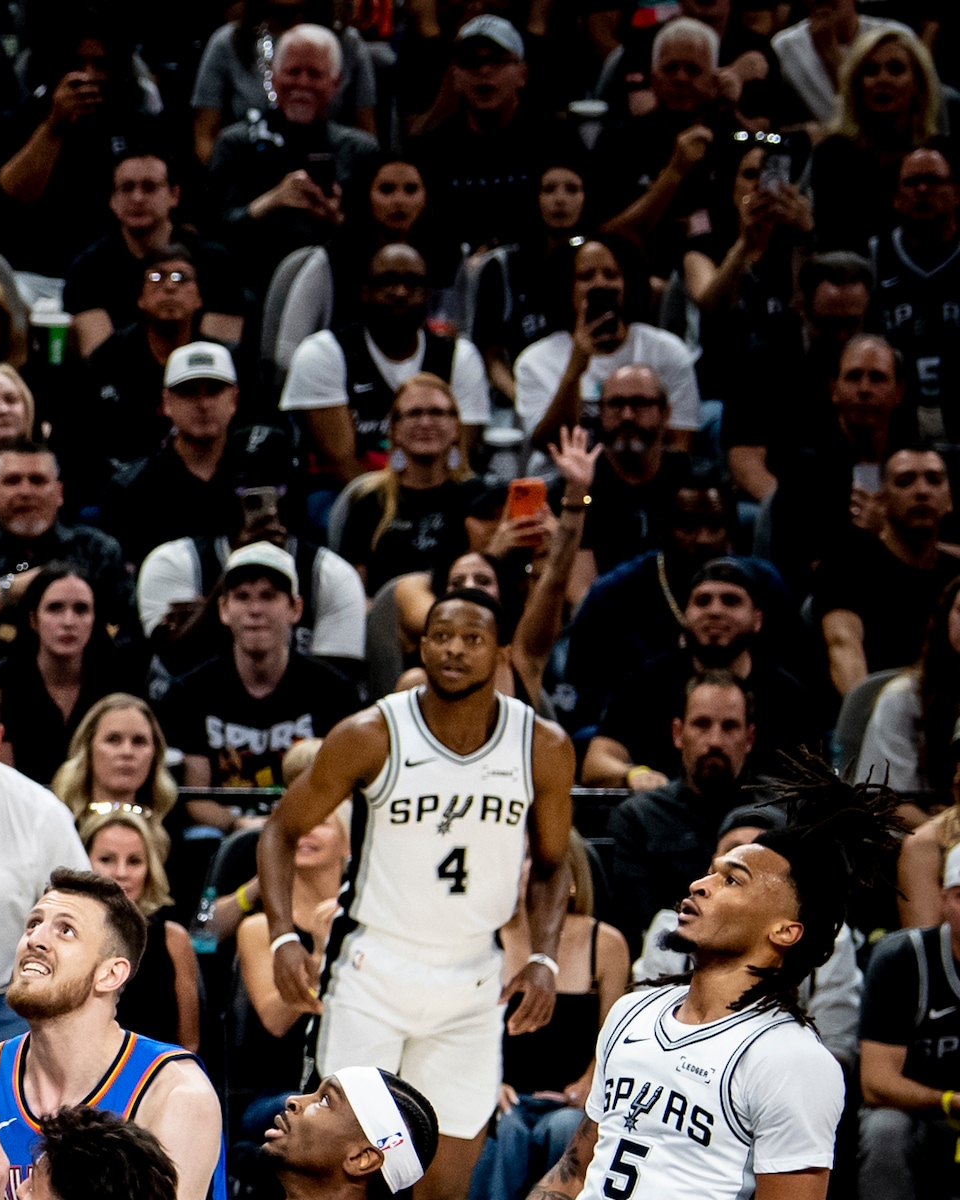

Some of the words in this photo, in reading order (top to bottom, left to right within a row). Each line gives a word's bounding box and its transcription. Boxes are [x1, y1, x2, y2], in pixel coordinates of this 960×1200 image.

[390, 794, 524, 835] SPURS
[436, 846, 468, 895] 4
[681, 1061, 709, 1078] LEDGER
